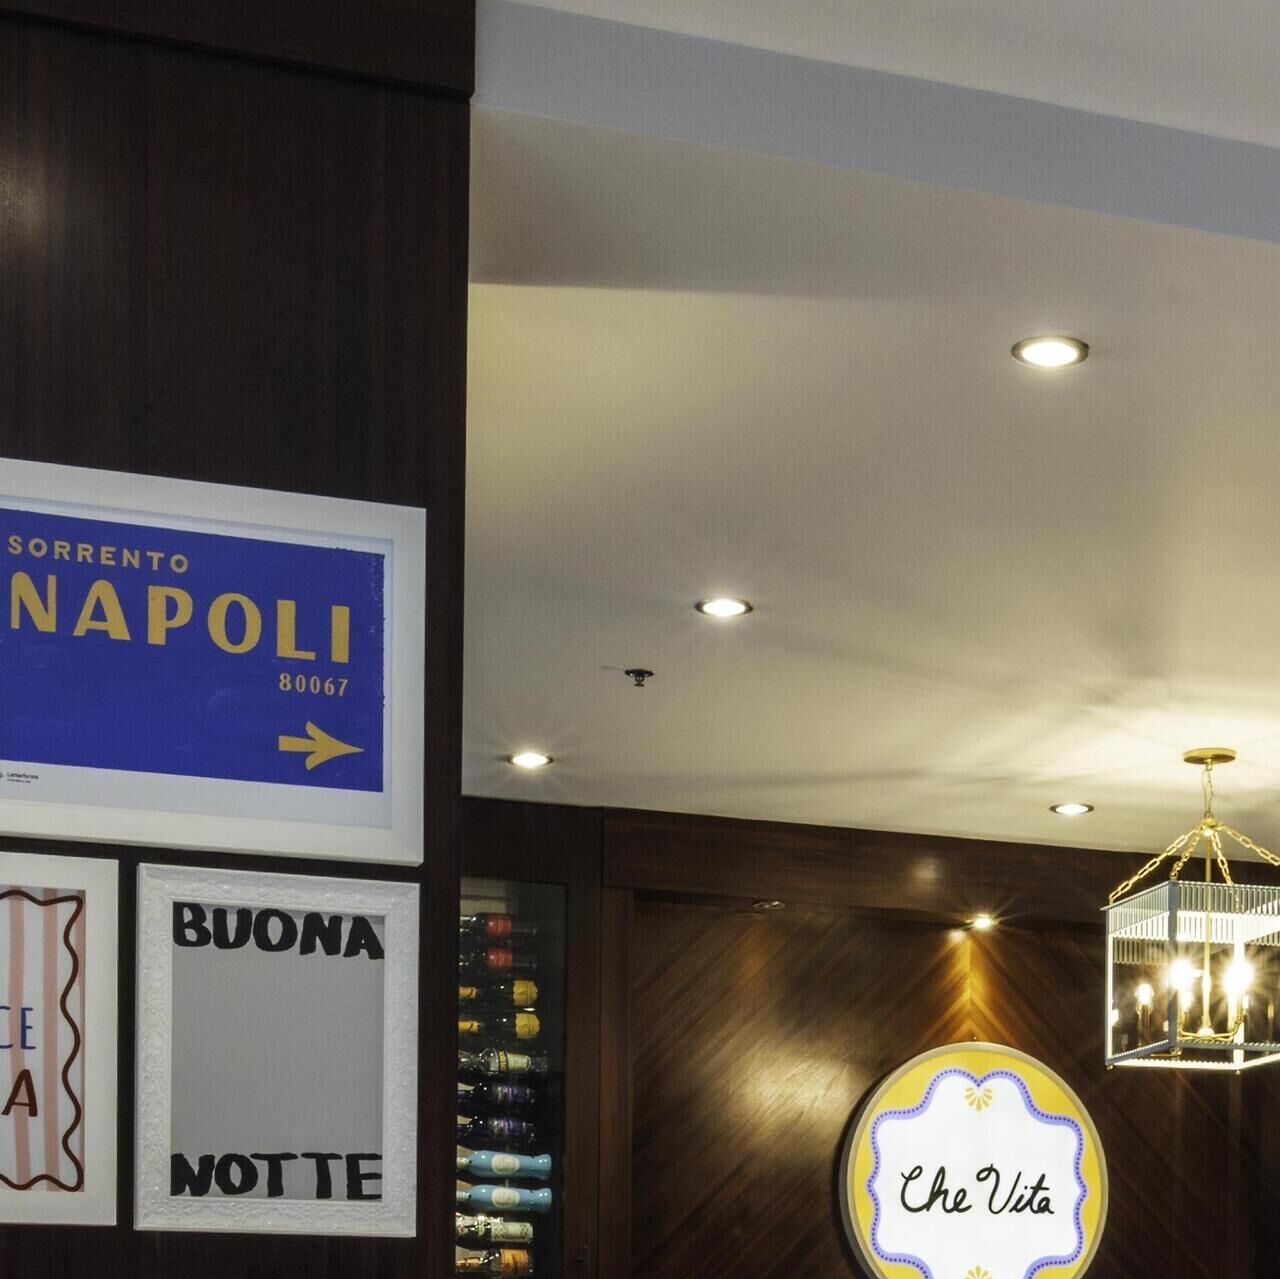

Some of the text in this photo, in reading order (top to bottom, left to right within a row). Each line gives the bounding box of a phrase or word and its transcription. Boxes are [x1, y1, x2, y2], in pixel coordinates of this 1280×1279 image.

[7, 535, 190, 574] SORRENTO
[10, 571, 351, 664] NAPOLI
[279, 672, 349, 697] 80067
[172, 901, 385, 960] BUONA
[170, 1152, 383, 1200] NOTTE
[900, 1163, 1055, 1215] Che Vita
